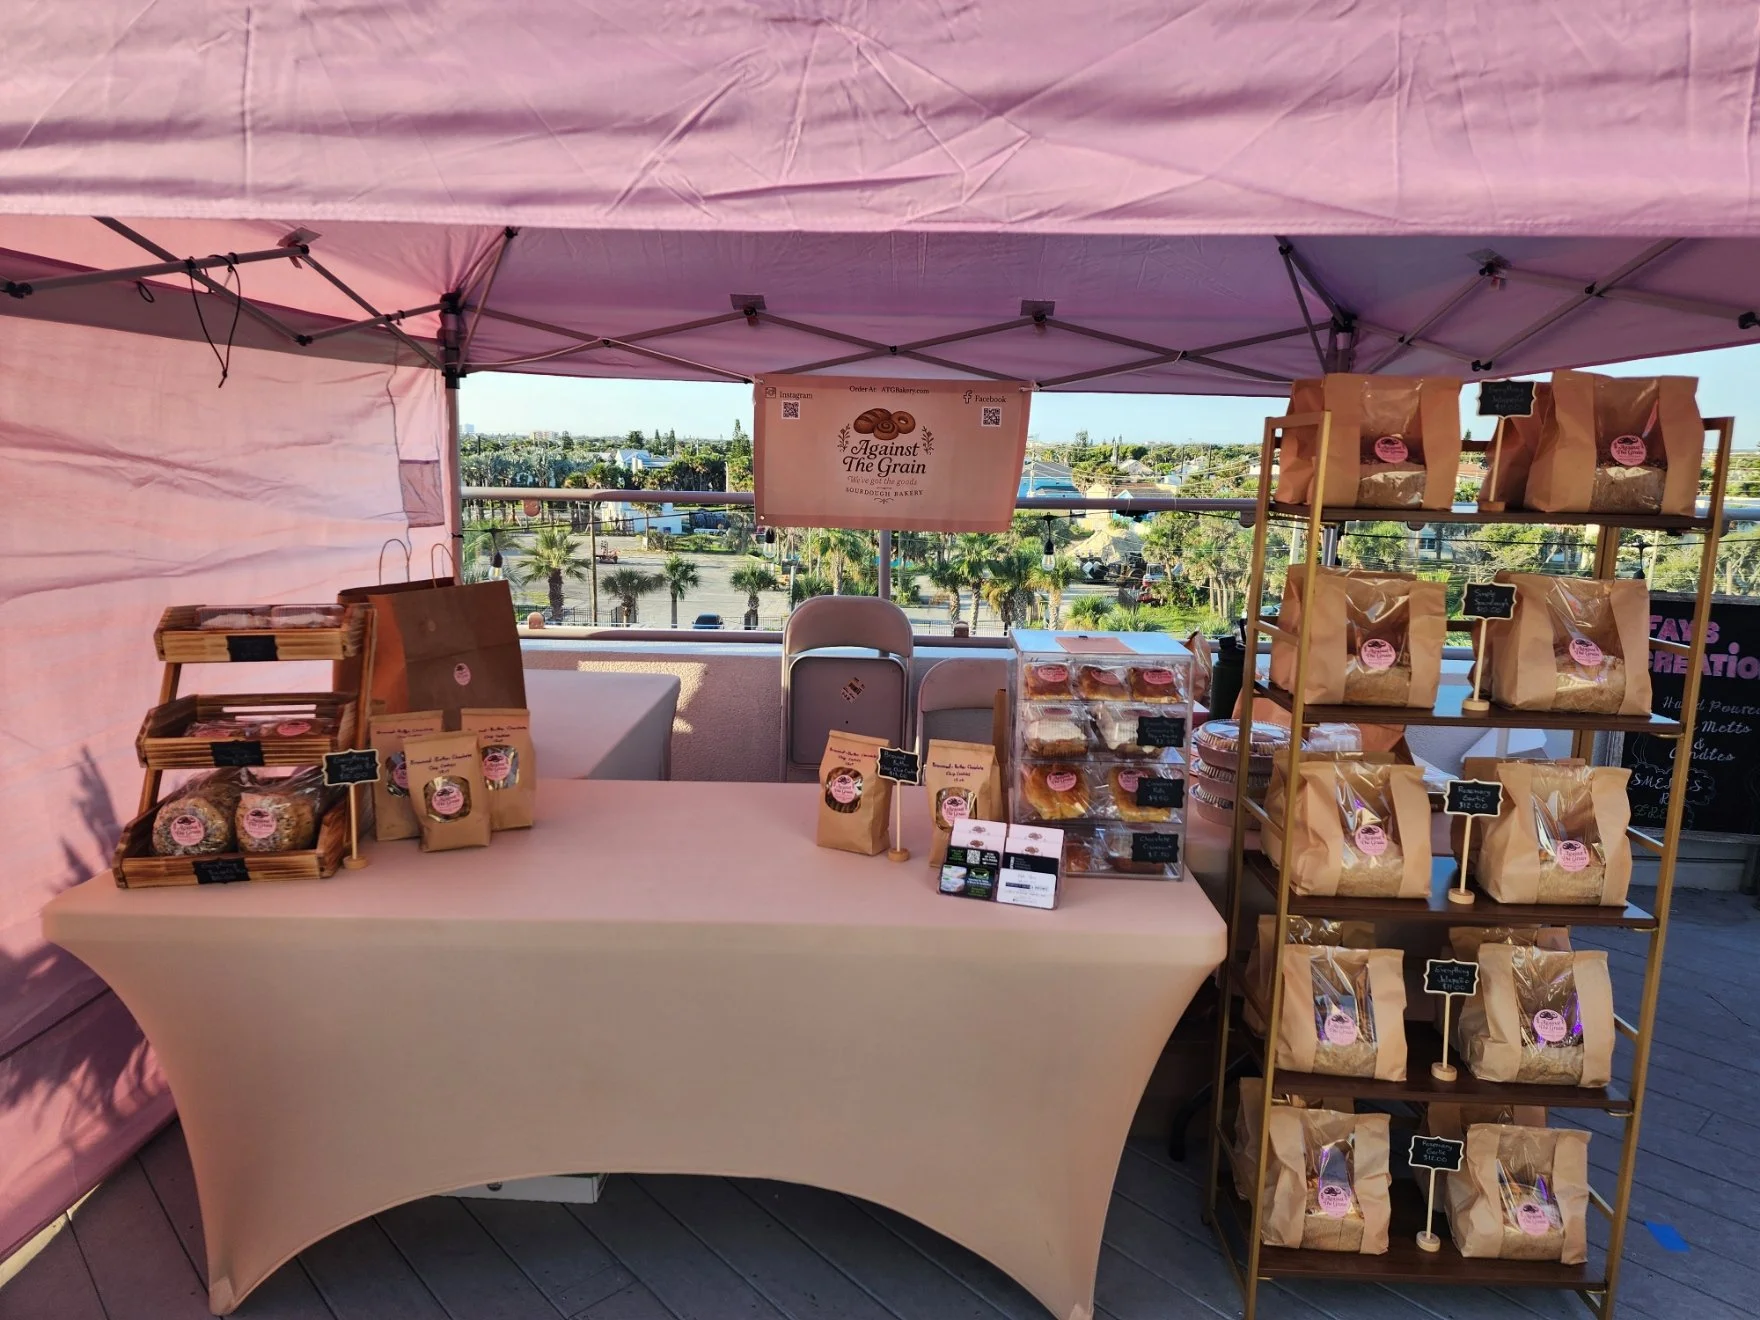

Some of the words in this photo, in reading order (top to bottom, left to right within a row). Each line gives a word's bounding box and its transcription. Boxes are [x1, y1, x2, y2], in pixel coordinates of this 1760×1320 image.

[849, 384, 868, 392] Order
[881, 386, 930, 397] ATGBakery.com
[779, 391, 813, 401] Instagram
[975, 395, 1008, 404] Facebook
[850, 439, 920, 459] Against
[842, 455, 874, 472] The
[878, 456, 926, 478] Grain
[869, 478, 882, 486] got
[883, 477, 896, 485] the
[896, 478, 918, 487] goods
[846, 487, 891, 497] SOURDOUGH
[893, 489, 925, 497] BAKERY
[1662, 696, 1704, 711] Had
[1702, 720, 1753, 735] Melts
[1693, 738, 1706, 751] &
[1669, 746, 1736, 761] Cndles
